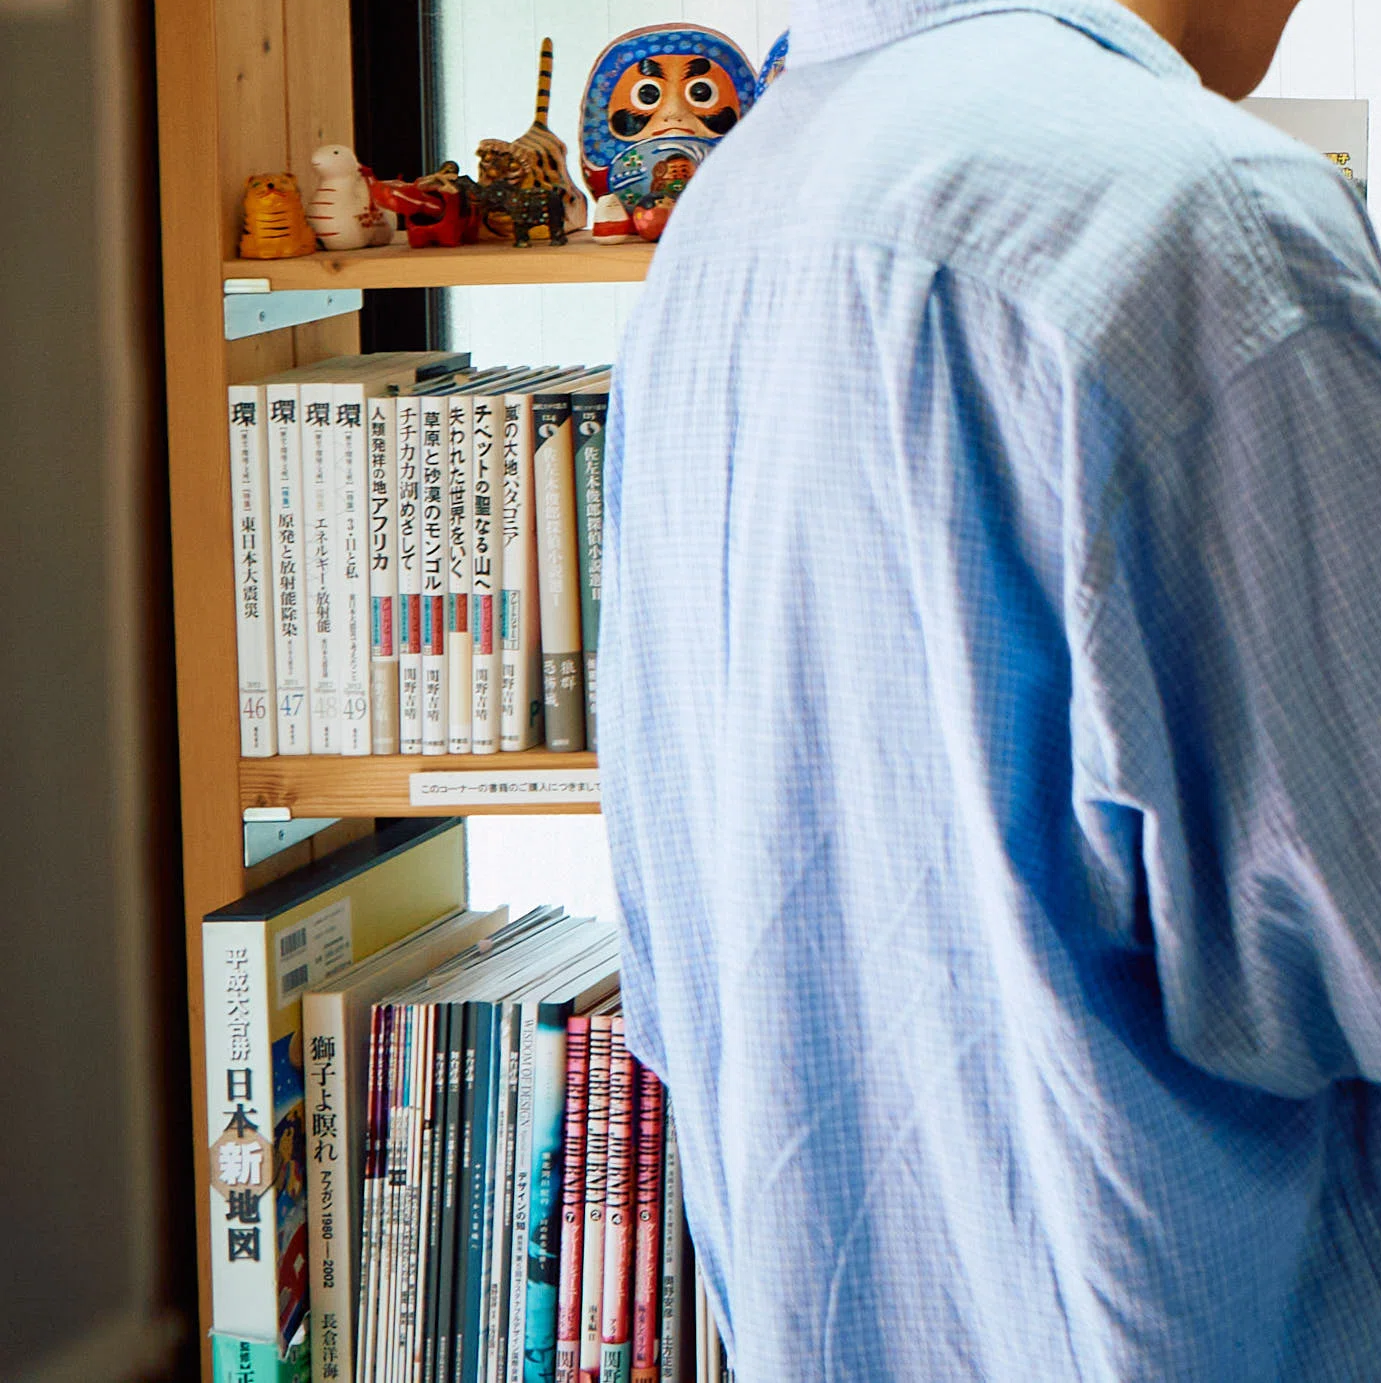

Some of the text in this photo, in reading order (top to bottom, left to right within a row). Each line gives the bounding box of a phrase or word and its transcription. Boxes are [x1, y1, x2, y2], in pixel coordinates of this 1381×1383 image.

[231, 401, 257, 428] 環
[270, 399, 297, 425] 環
[305, 402, 331, 428] 環
[336, 403, 362, 429] 環
[400, 407, 419, 571] チチカカ湖めざして
[424, 411, 442, 590] 草原と砂漠のモンゴル
[449, 406, 466, 579] 失われた世界をいく
[474, 404, 493, 589] チベットの聖なる山へ
[241, 516, 259, 619] 東日本大震災
[278, 513, 298, 638] 原発と放射能除染
[315, 518, 332, 634] エネルギー・放射能
[243, 696, 267, 720] 46
[280, 693, 304, 717] 47
[343, 697, 367, 721] 49
[519, 1019, 534, 1126] WISDOM OF DESIGN
[218, 1067, 262, 1261] 日本新地図
[321, 1313, 339, 1379] 長倉洋海
